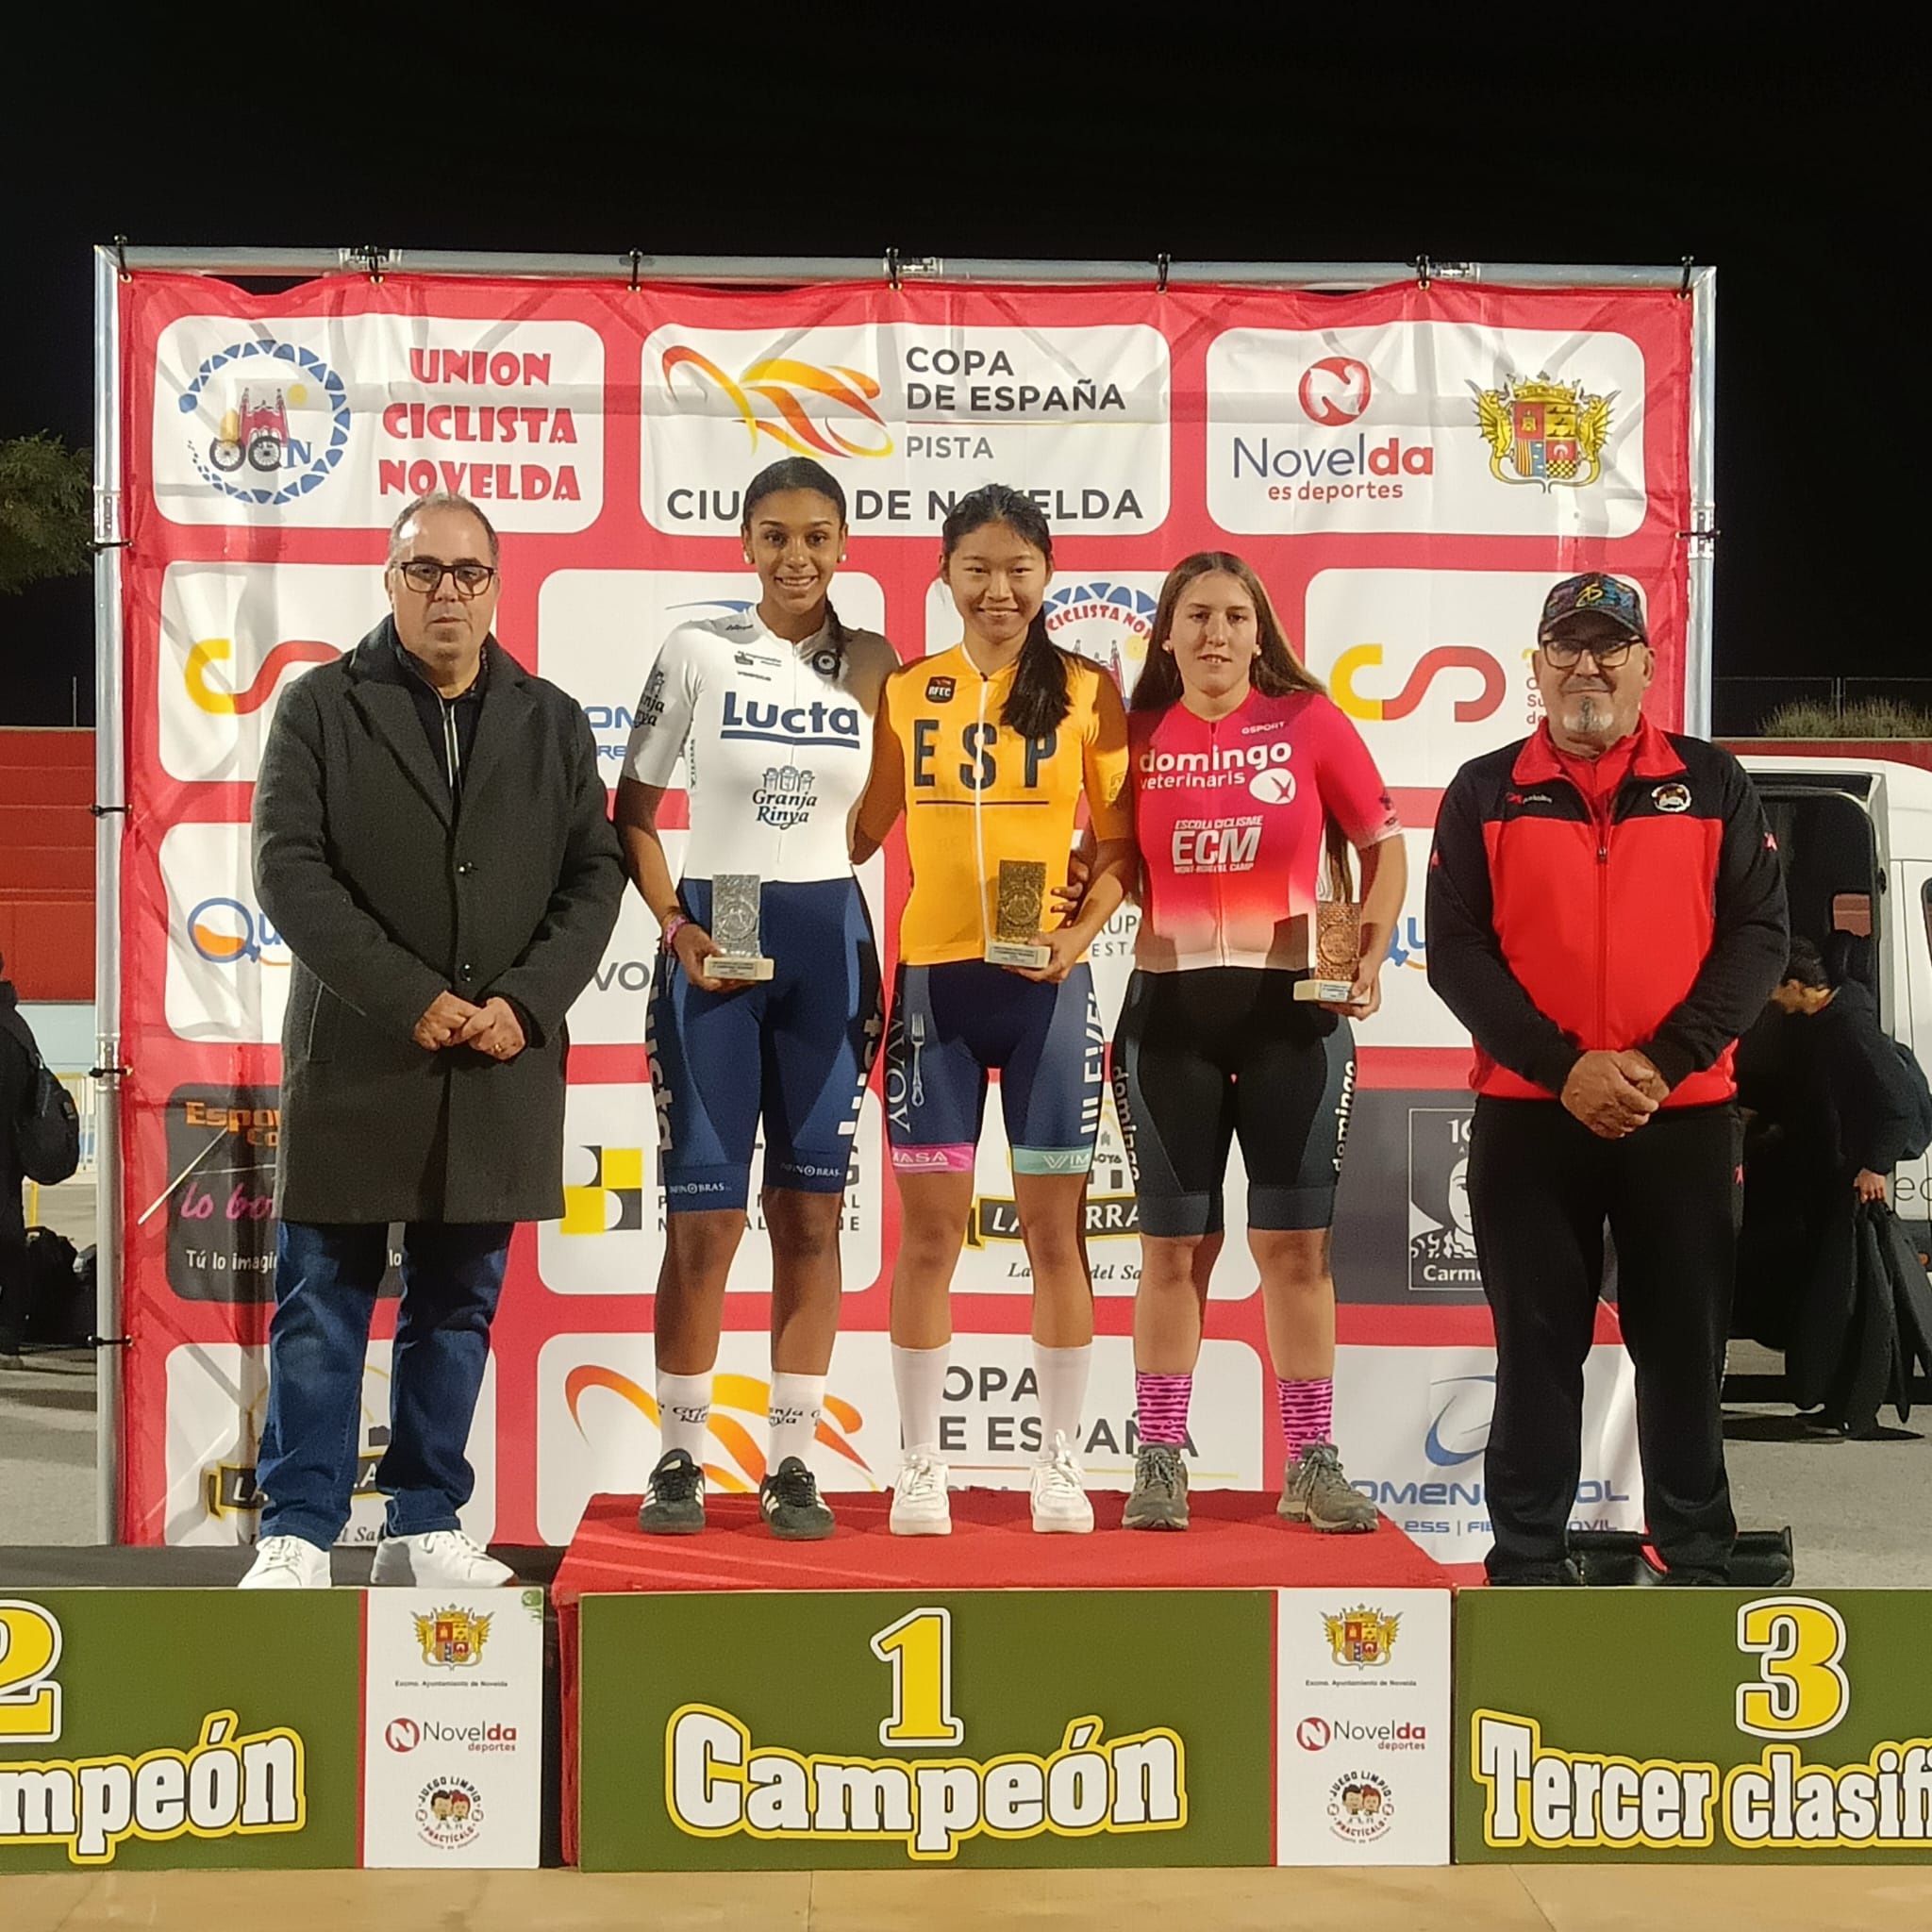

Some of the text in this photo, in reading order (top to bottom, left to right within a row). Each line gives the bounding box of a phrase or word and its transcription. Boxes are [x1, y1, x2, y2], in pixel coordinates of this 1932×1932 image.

[409, 347, 551, 386] UNION
[906, 346, 1014, 376] COPA
[907, 379, 1126, 411] DE ESPAÑA
[382, 403, 578, 444] CICLISTA
[906, 437, 994, 459] PISTA
[1233, 433, 1433, 478] Novelda
[380, 459, 581, 501] NOVELDA
[1268, 482, 1404, 504] es deportes
[855, 490, 911, 520] DE
[928, 489, 1143, 520] NELDA
[1046, 604, 1120, 631] CICLISTA
[722, 691, 859, 737] Lucta
[913, 719, 1058, 790] ESP
[1139, 741, 1292, 773] domingo
[1140, 771, 1246, 790] veterinaris
[752, 789, 818, 808] Granja
[755, 806, 809, 830] Rinya
[1175, 815, 1263, 830] ESCOLA CICLISME
[1173, 826, 1262, 865] ECM
[186, 1250, 206, 1270] Tú
[212, 1252, 226, 1271] lo
[389, 1250, 402, 1267] lo
[941, 1366, 1039, 1403] OPA
[870, 1607, 964, 1747] 1
[1736, 1596, 1850, 1739] 3
[424, 1721, 517, 1741] Novelda
[1334, 1720, 1426, 1740] Novelda
[468, 1742, 516, 1754] deportes
[1378, 1740, 1426, 1752] deportes
[0, 1711, 304, 1862] mpeón
[418, 1775, 482, 1804] JUEGO LIMPIO
[668, 1705, 1186, 1858] Campeón
[1329, 1770, 1392, 1797] JUEGO LIMPIO
[1474, 1711, 1717, 1845] Tercer
